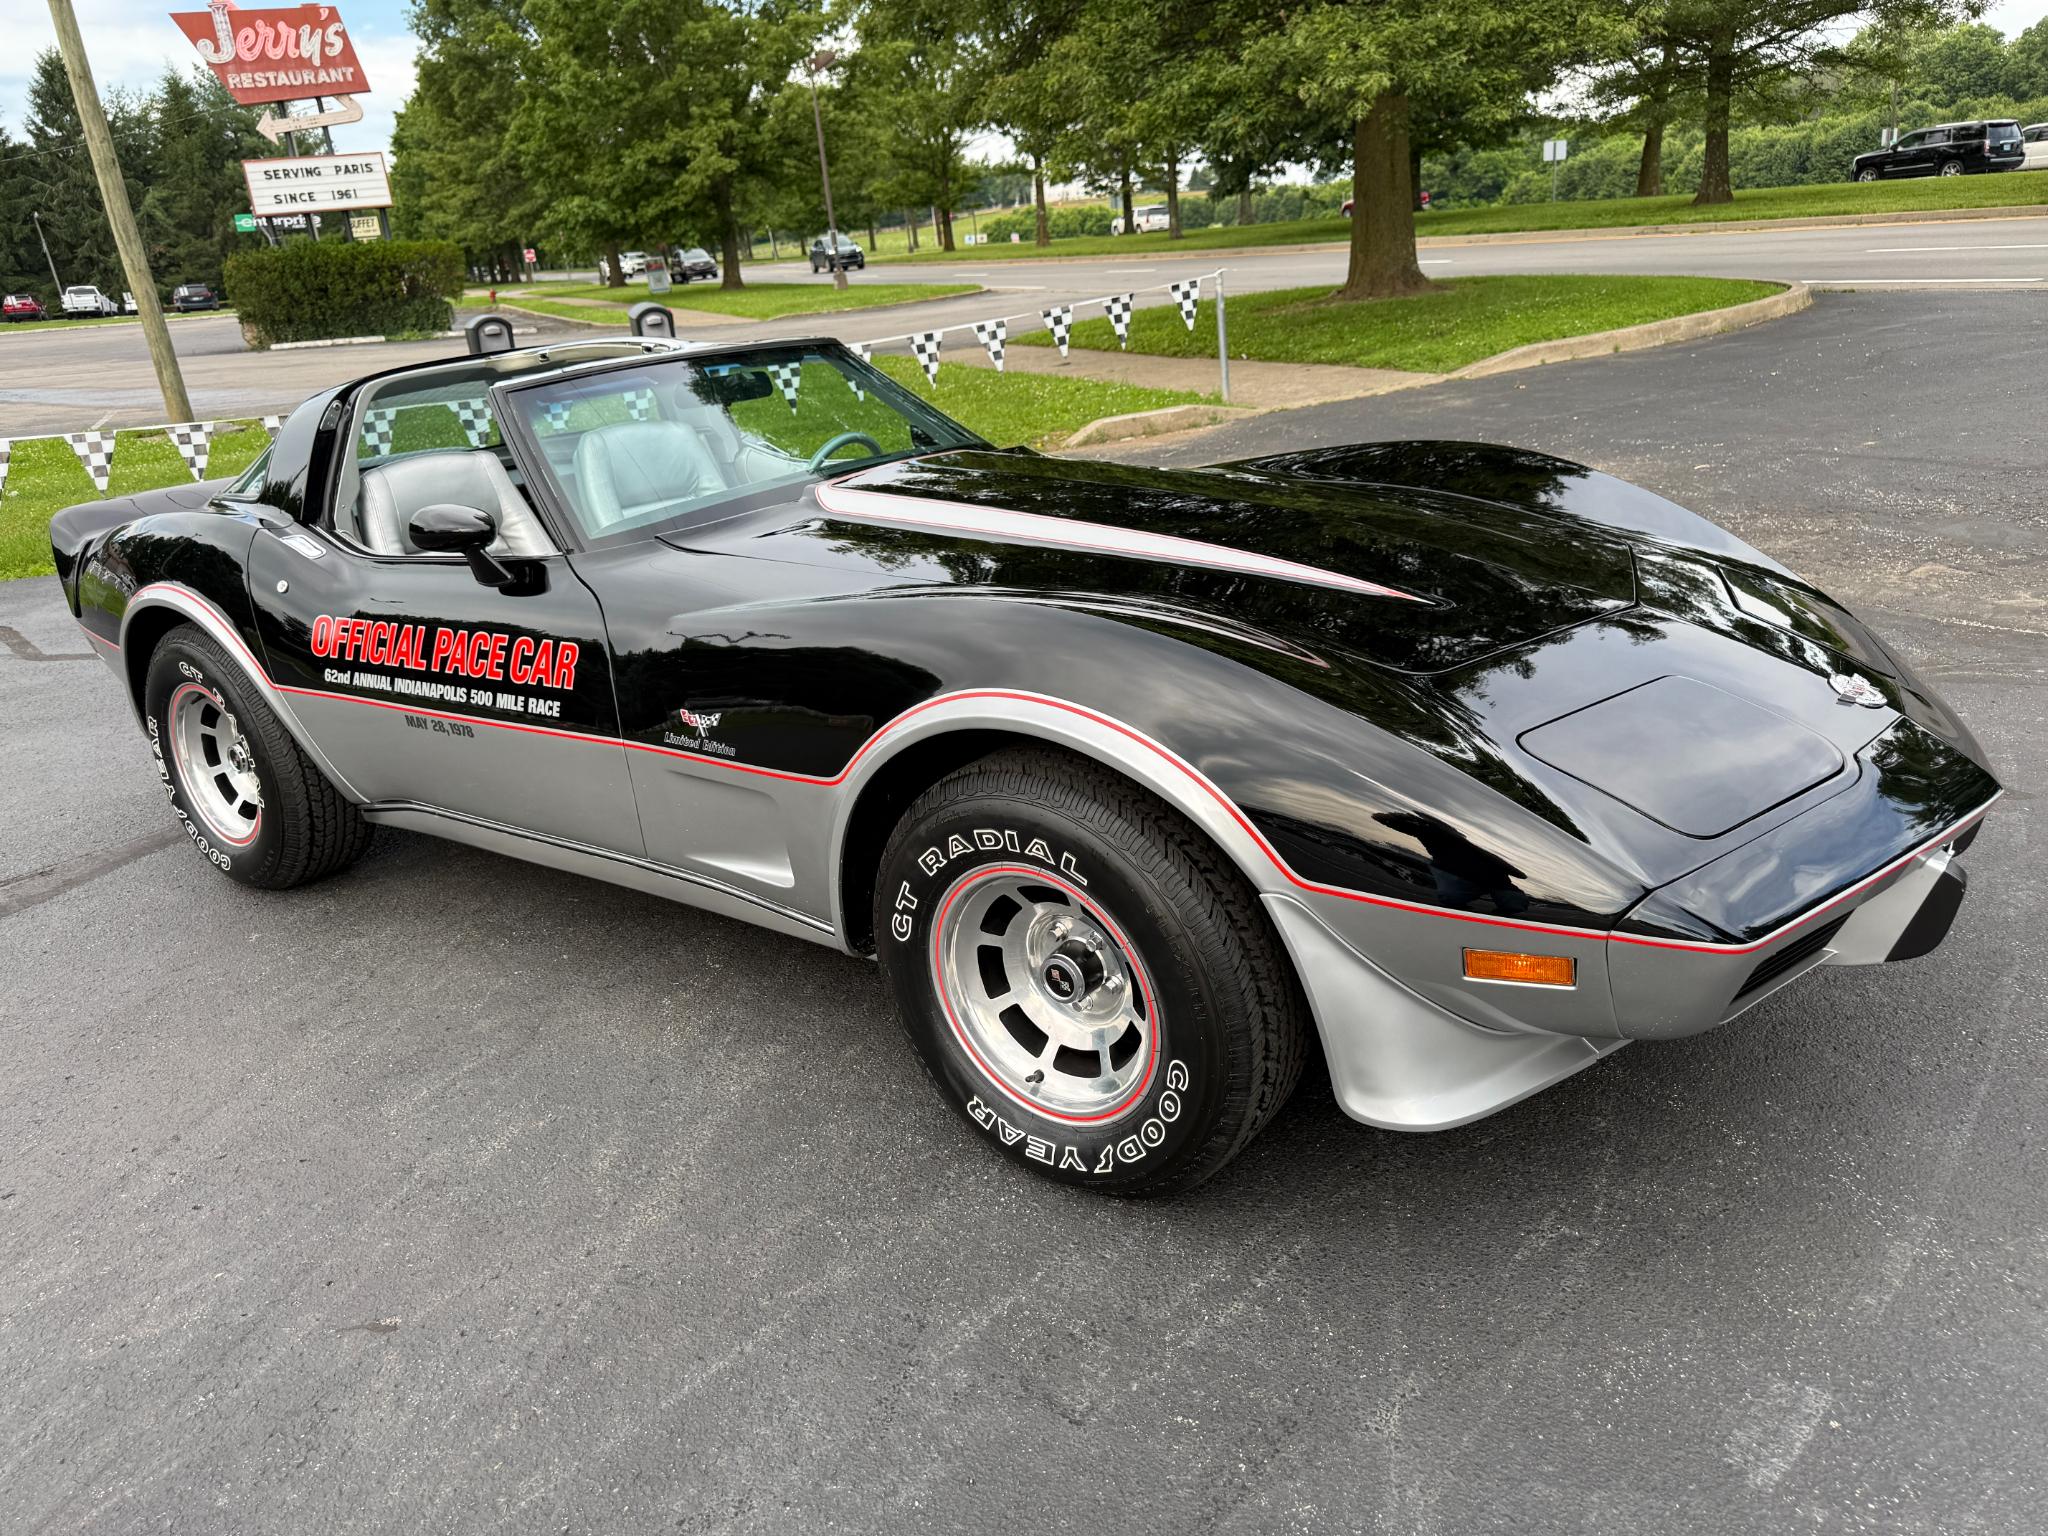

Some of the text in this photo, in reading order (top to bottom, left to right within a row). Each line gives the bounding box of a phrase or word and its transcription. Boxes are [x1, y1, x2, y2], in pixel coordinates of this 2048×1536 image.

[196, 2, 344, 67] Jerry's
[227, 67, 354, 89] RESTAURANT
[263, 163, 373, 180] SERVING PARIS
[274, 189, 358, 204] SINCE 1961
[310, 614, 580, 690] OFFICIAL PACE CAR
[179, 661, 203, 684] GT
[324, 668, 561, 717] 62nd ANNUAL INDIANAPOLIS 500 MILE RACE
[404, 715, 429, 730] MAY
[892, 829, 1088, 942] GT RADIAL
